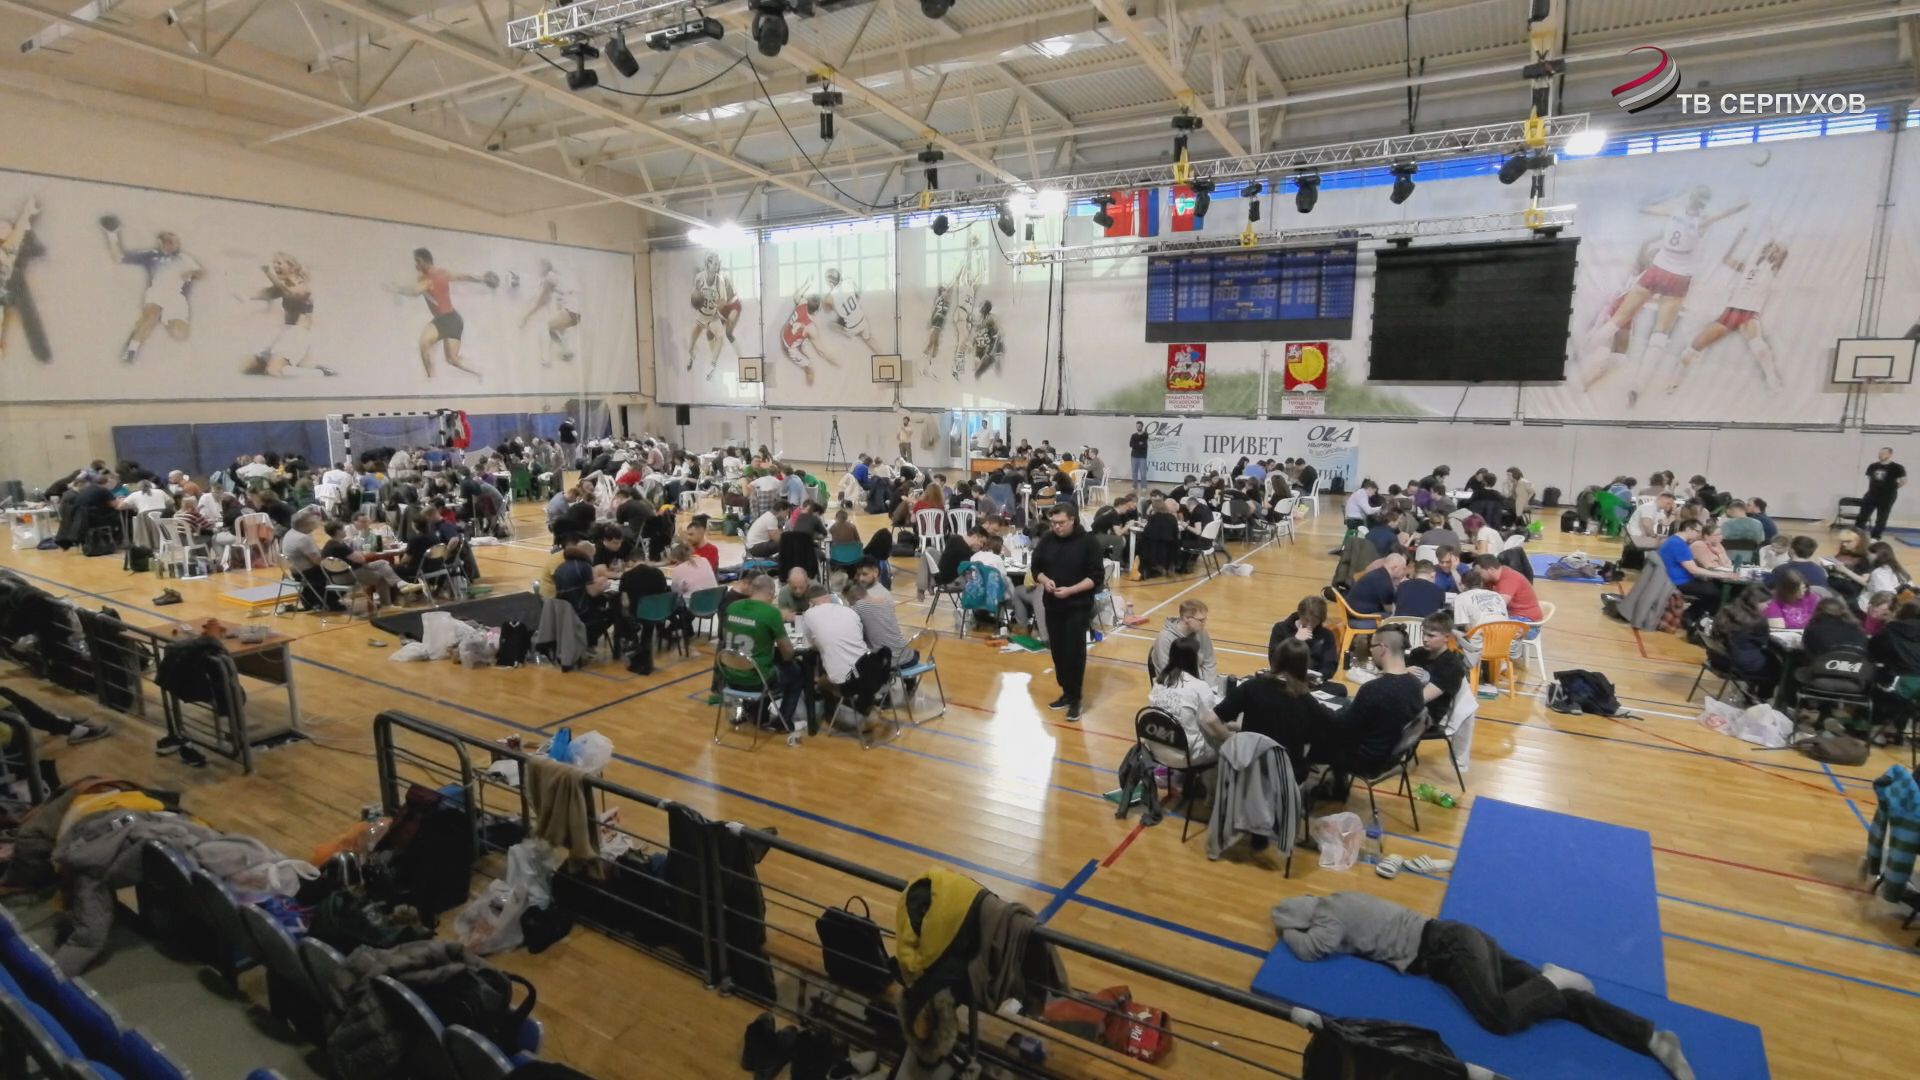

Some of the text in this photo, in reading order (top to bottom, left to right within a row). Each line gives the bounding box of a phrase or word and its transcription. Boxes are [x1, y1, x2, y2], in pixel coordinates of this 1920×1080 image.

[842, 296, 857, 316] 10
[1307, 425, 1354, 442] ОКА
[1203, 435, 1282, 456] ПРИВЕТ
[1146, 460, 1227, 475] участни
